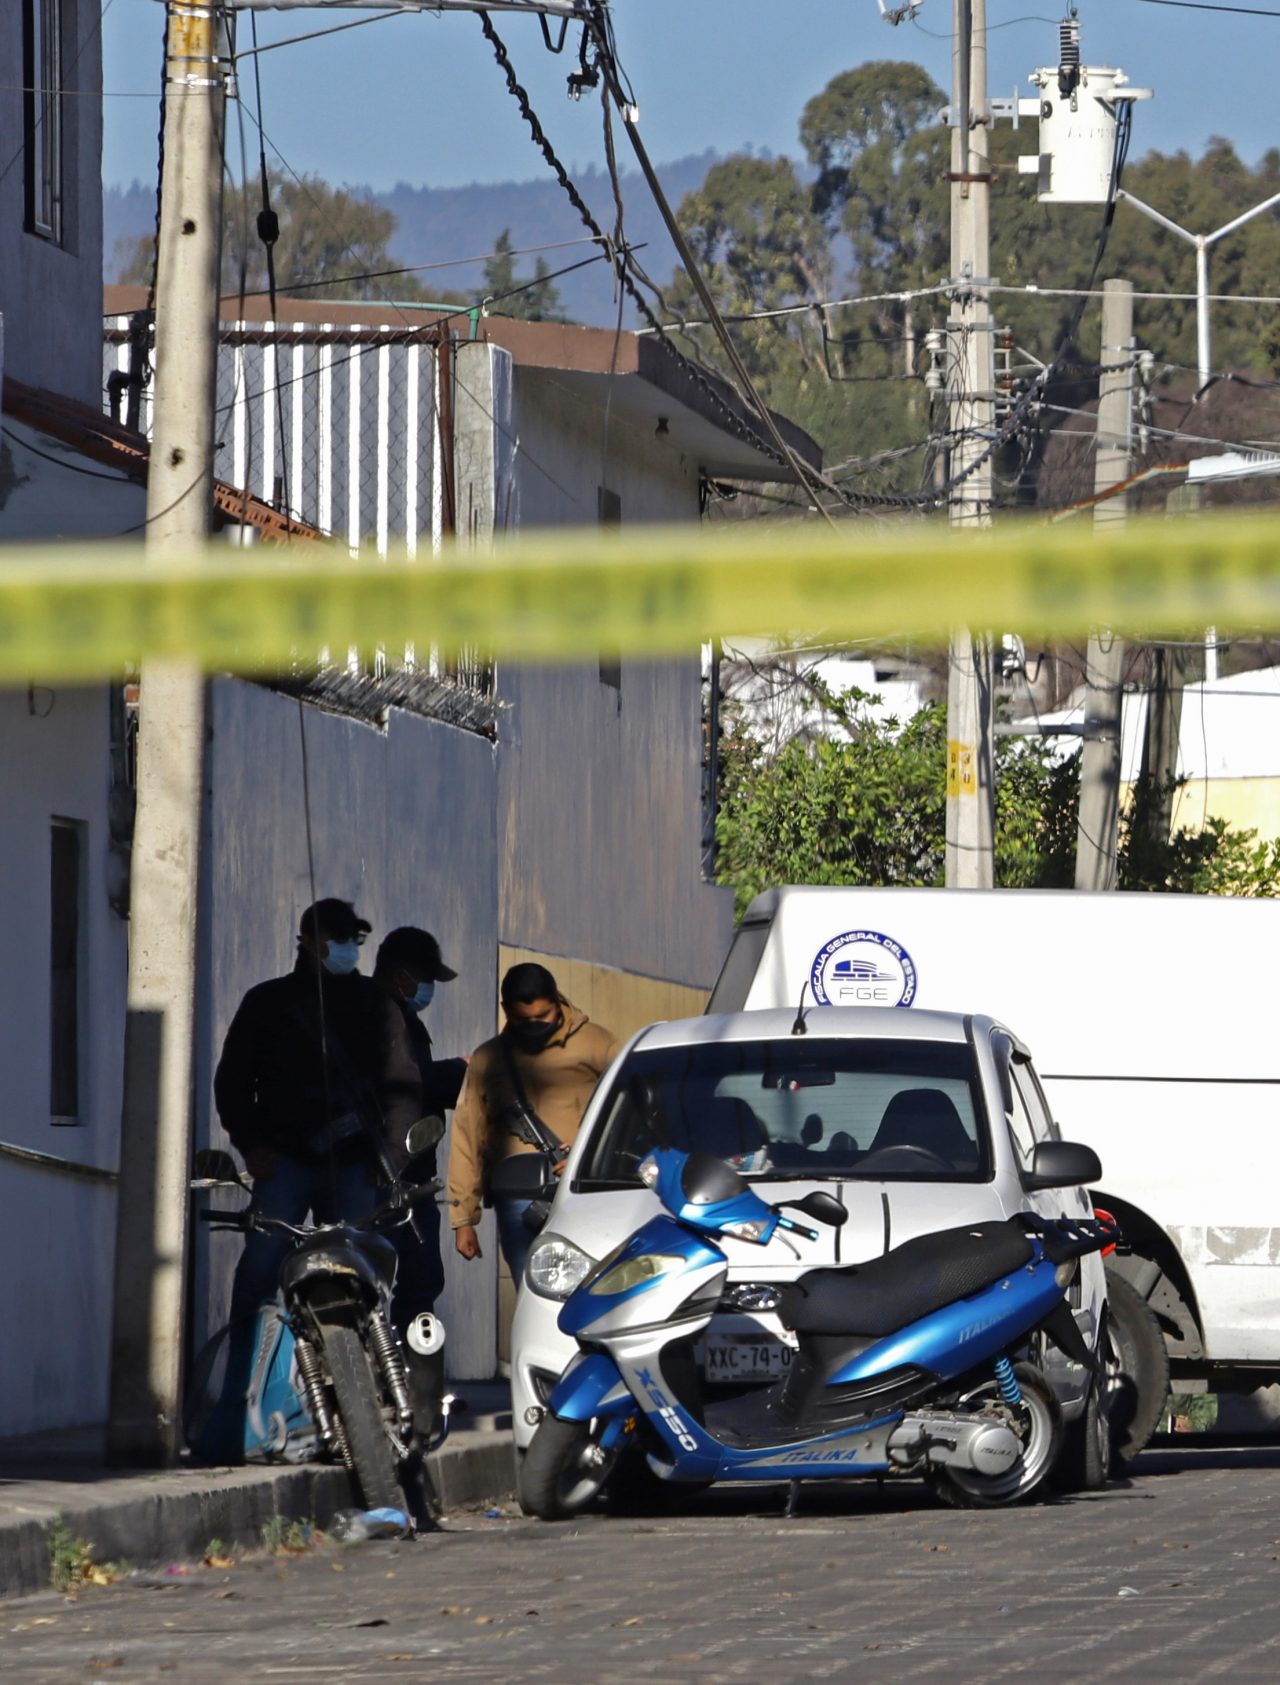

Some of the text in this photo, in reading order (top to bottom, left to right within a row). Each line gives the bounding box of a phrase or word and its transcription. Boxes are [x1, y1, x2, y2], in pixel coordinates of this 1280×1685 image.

[826, 932, 881, 954] GENERAL
[883, 938, 903, 959] DEL
[901, 958, 915, 1005] ESTADO
[839, 987, 889, 1001] FGE
[708, 1346, 798, 1368] XXC-74-0
[782, 1448, 857, 1463] ITALIKA
